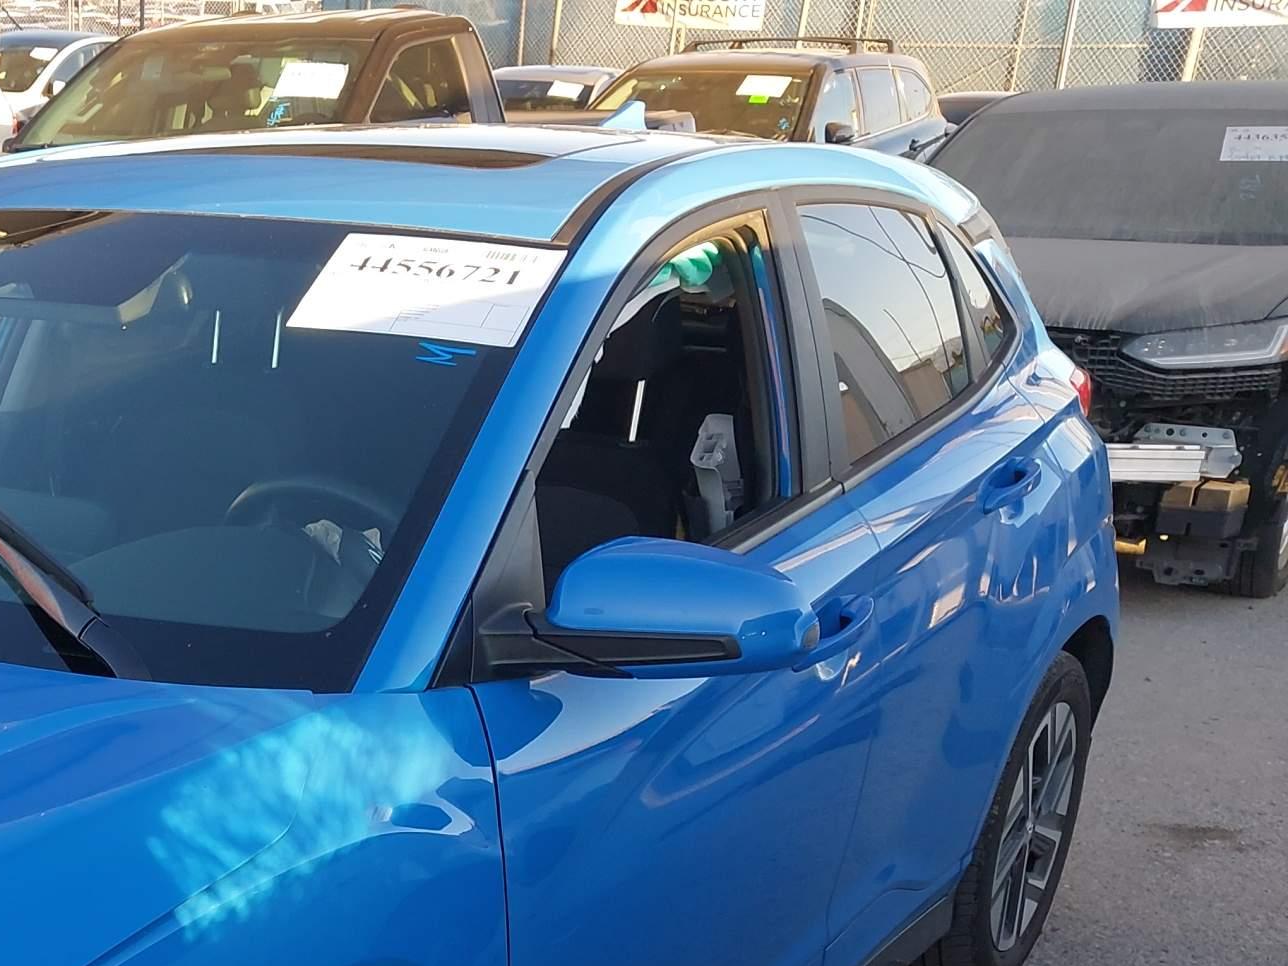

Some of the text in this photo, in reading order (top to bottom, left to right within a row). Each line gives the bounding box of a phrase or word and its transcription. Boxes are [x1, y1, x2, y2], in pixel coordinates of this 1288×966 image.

[660, 4, 761, 18] INSURANCE
[1213, 0, 1288, 11] INSUR
[350, 256, 521, 285] 44556721
